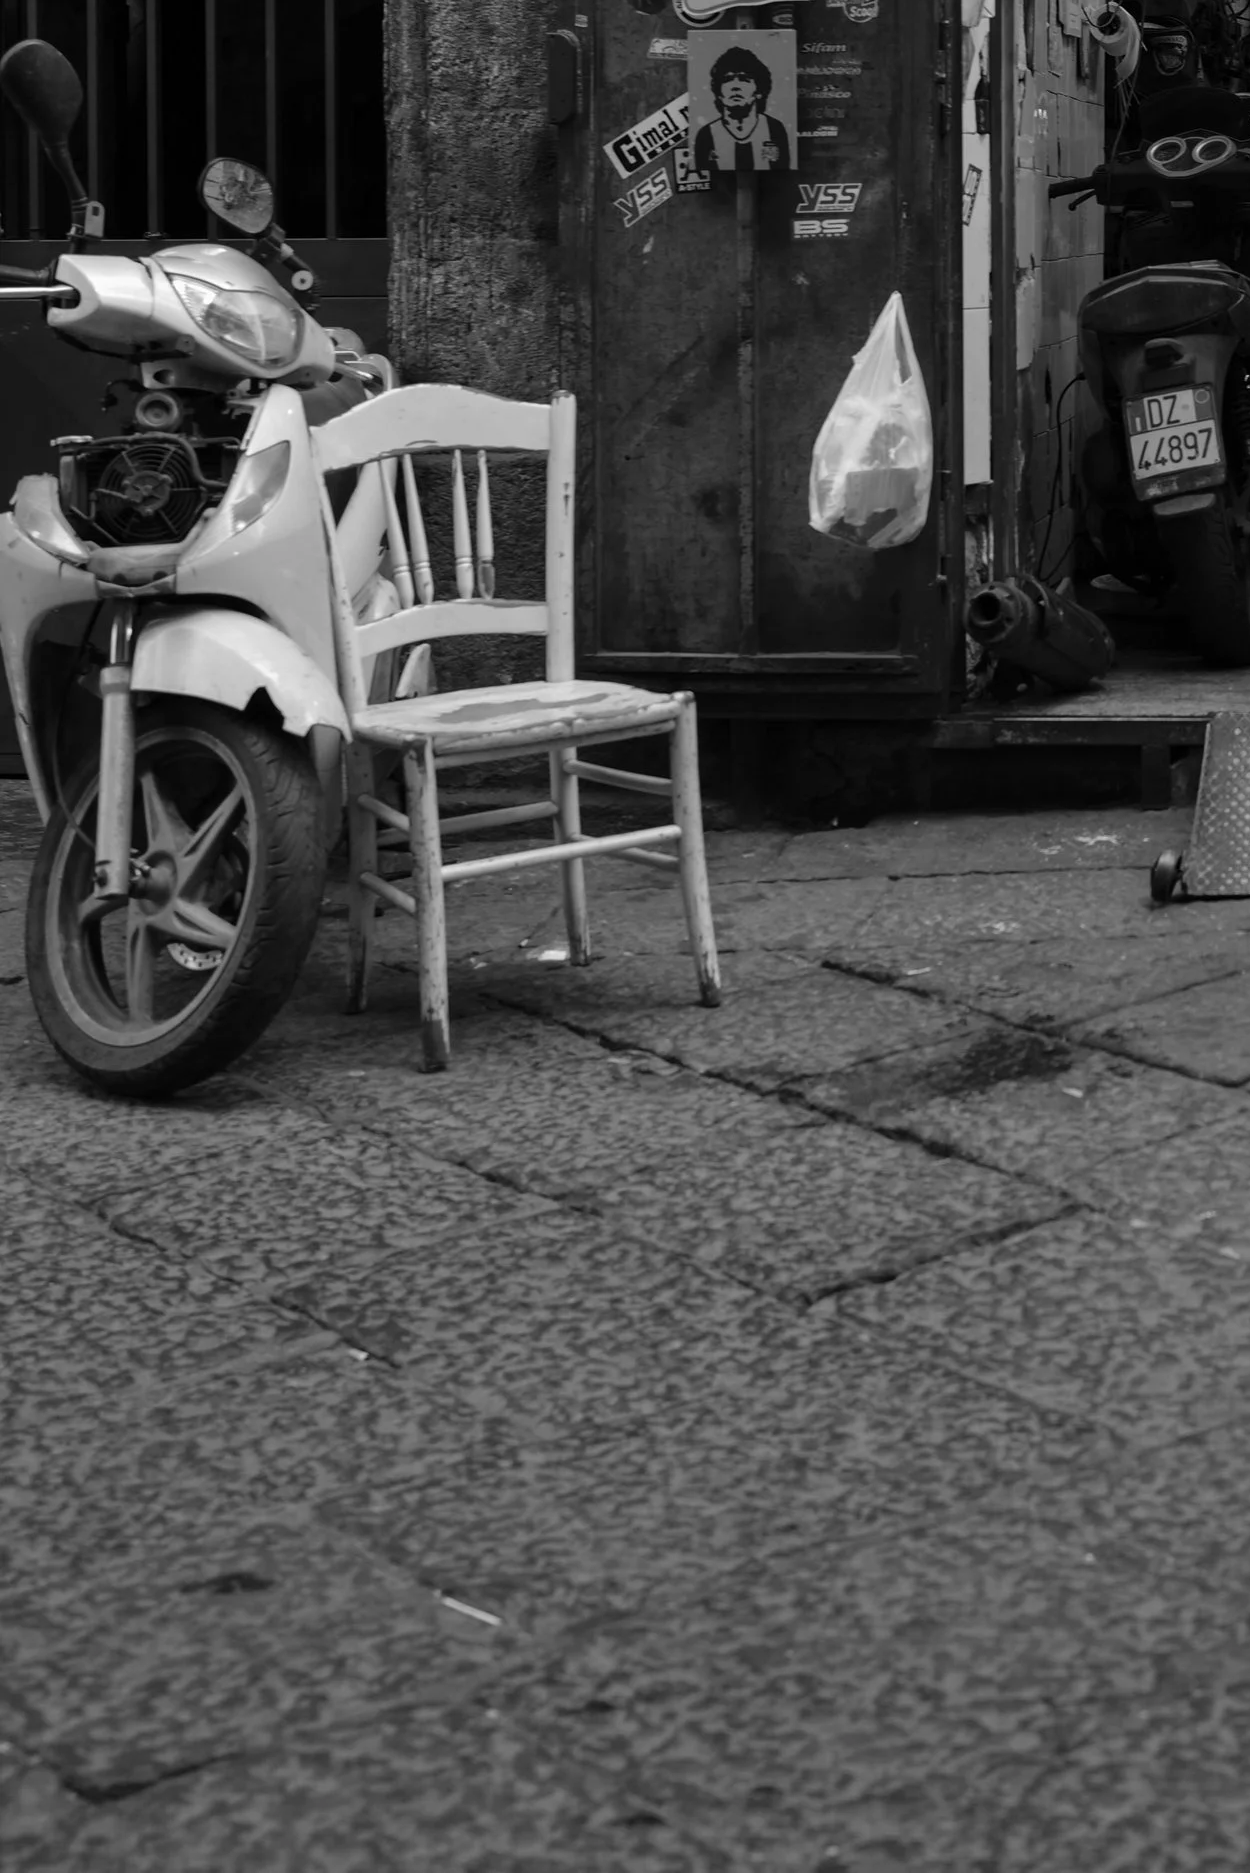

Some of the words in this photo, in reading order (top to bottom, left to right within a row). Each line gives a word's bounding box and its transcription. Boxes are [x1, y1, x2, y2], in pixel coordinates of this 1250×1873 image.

[612, 108, 680, 173] Gimal
[677, 182, 711, 193] A-STYLE
[793, 218, 851, 235] BS
[1146, 394, 1180, 429] DZ
[1137, 427, 1213, 471] 44897
